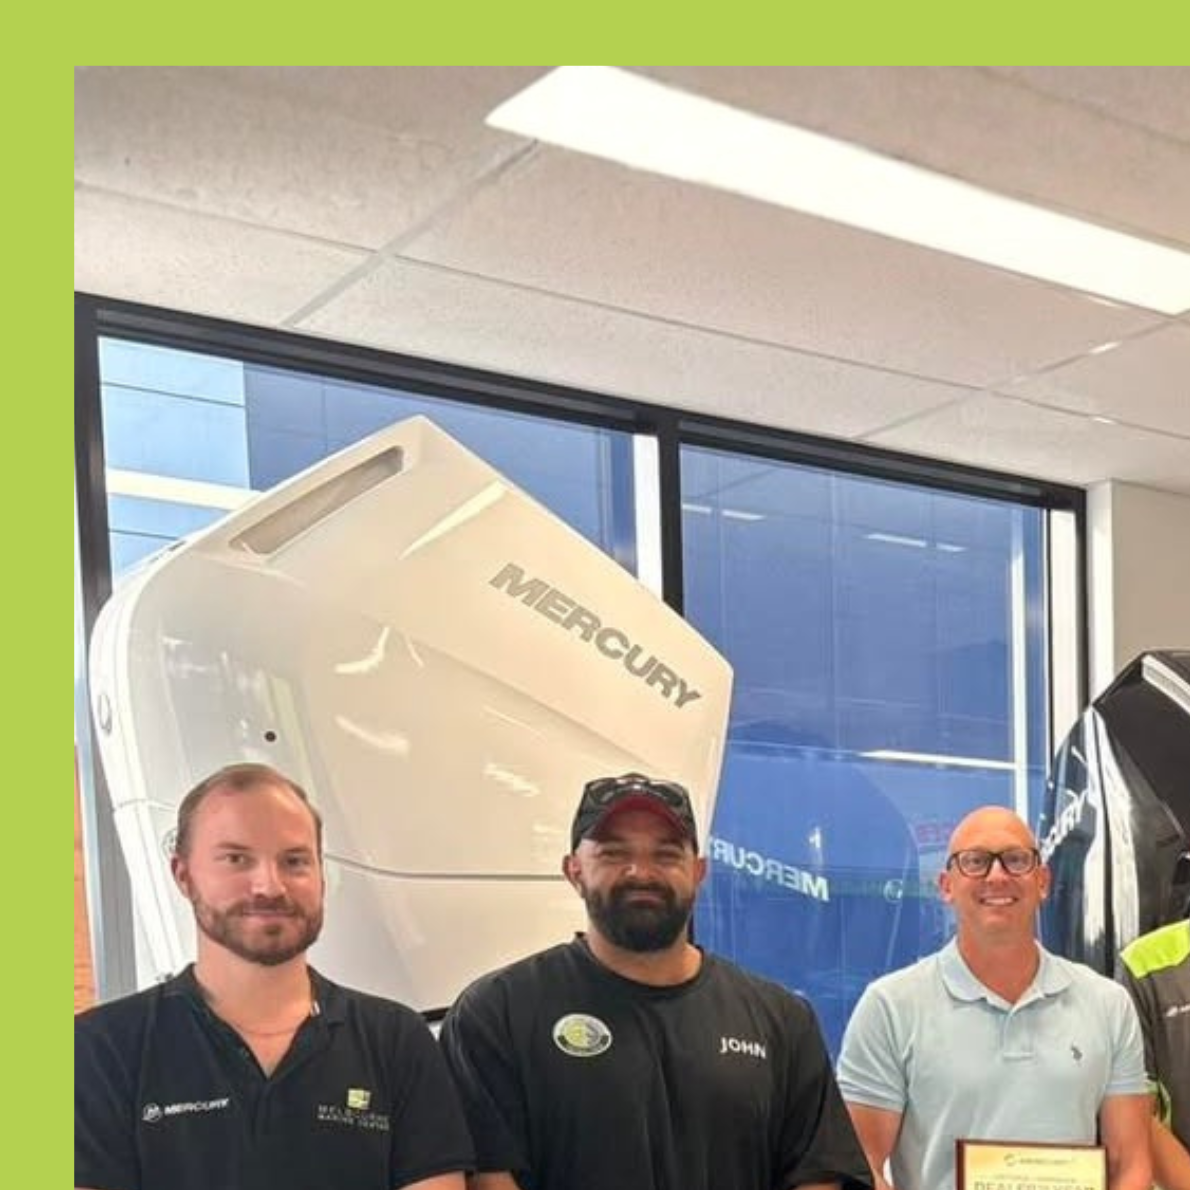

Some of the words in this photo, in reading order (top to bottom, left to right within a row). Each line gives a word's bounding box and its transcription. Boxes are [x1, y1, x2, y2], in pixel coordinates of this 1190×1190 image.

[489, 562, 702, 709] MERCURY
[719, 1036, 768, 1059] JOHN
[164, 1098, 230, 1116] MERCURY
